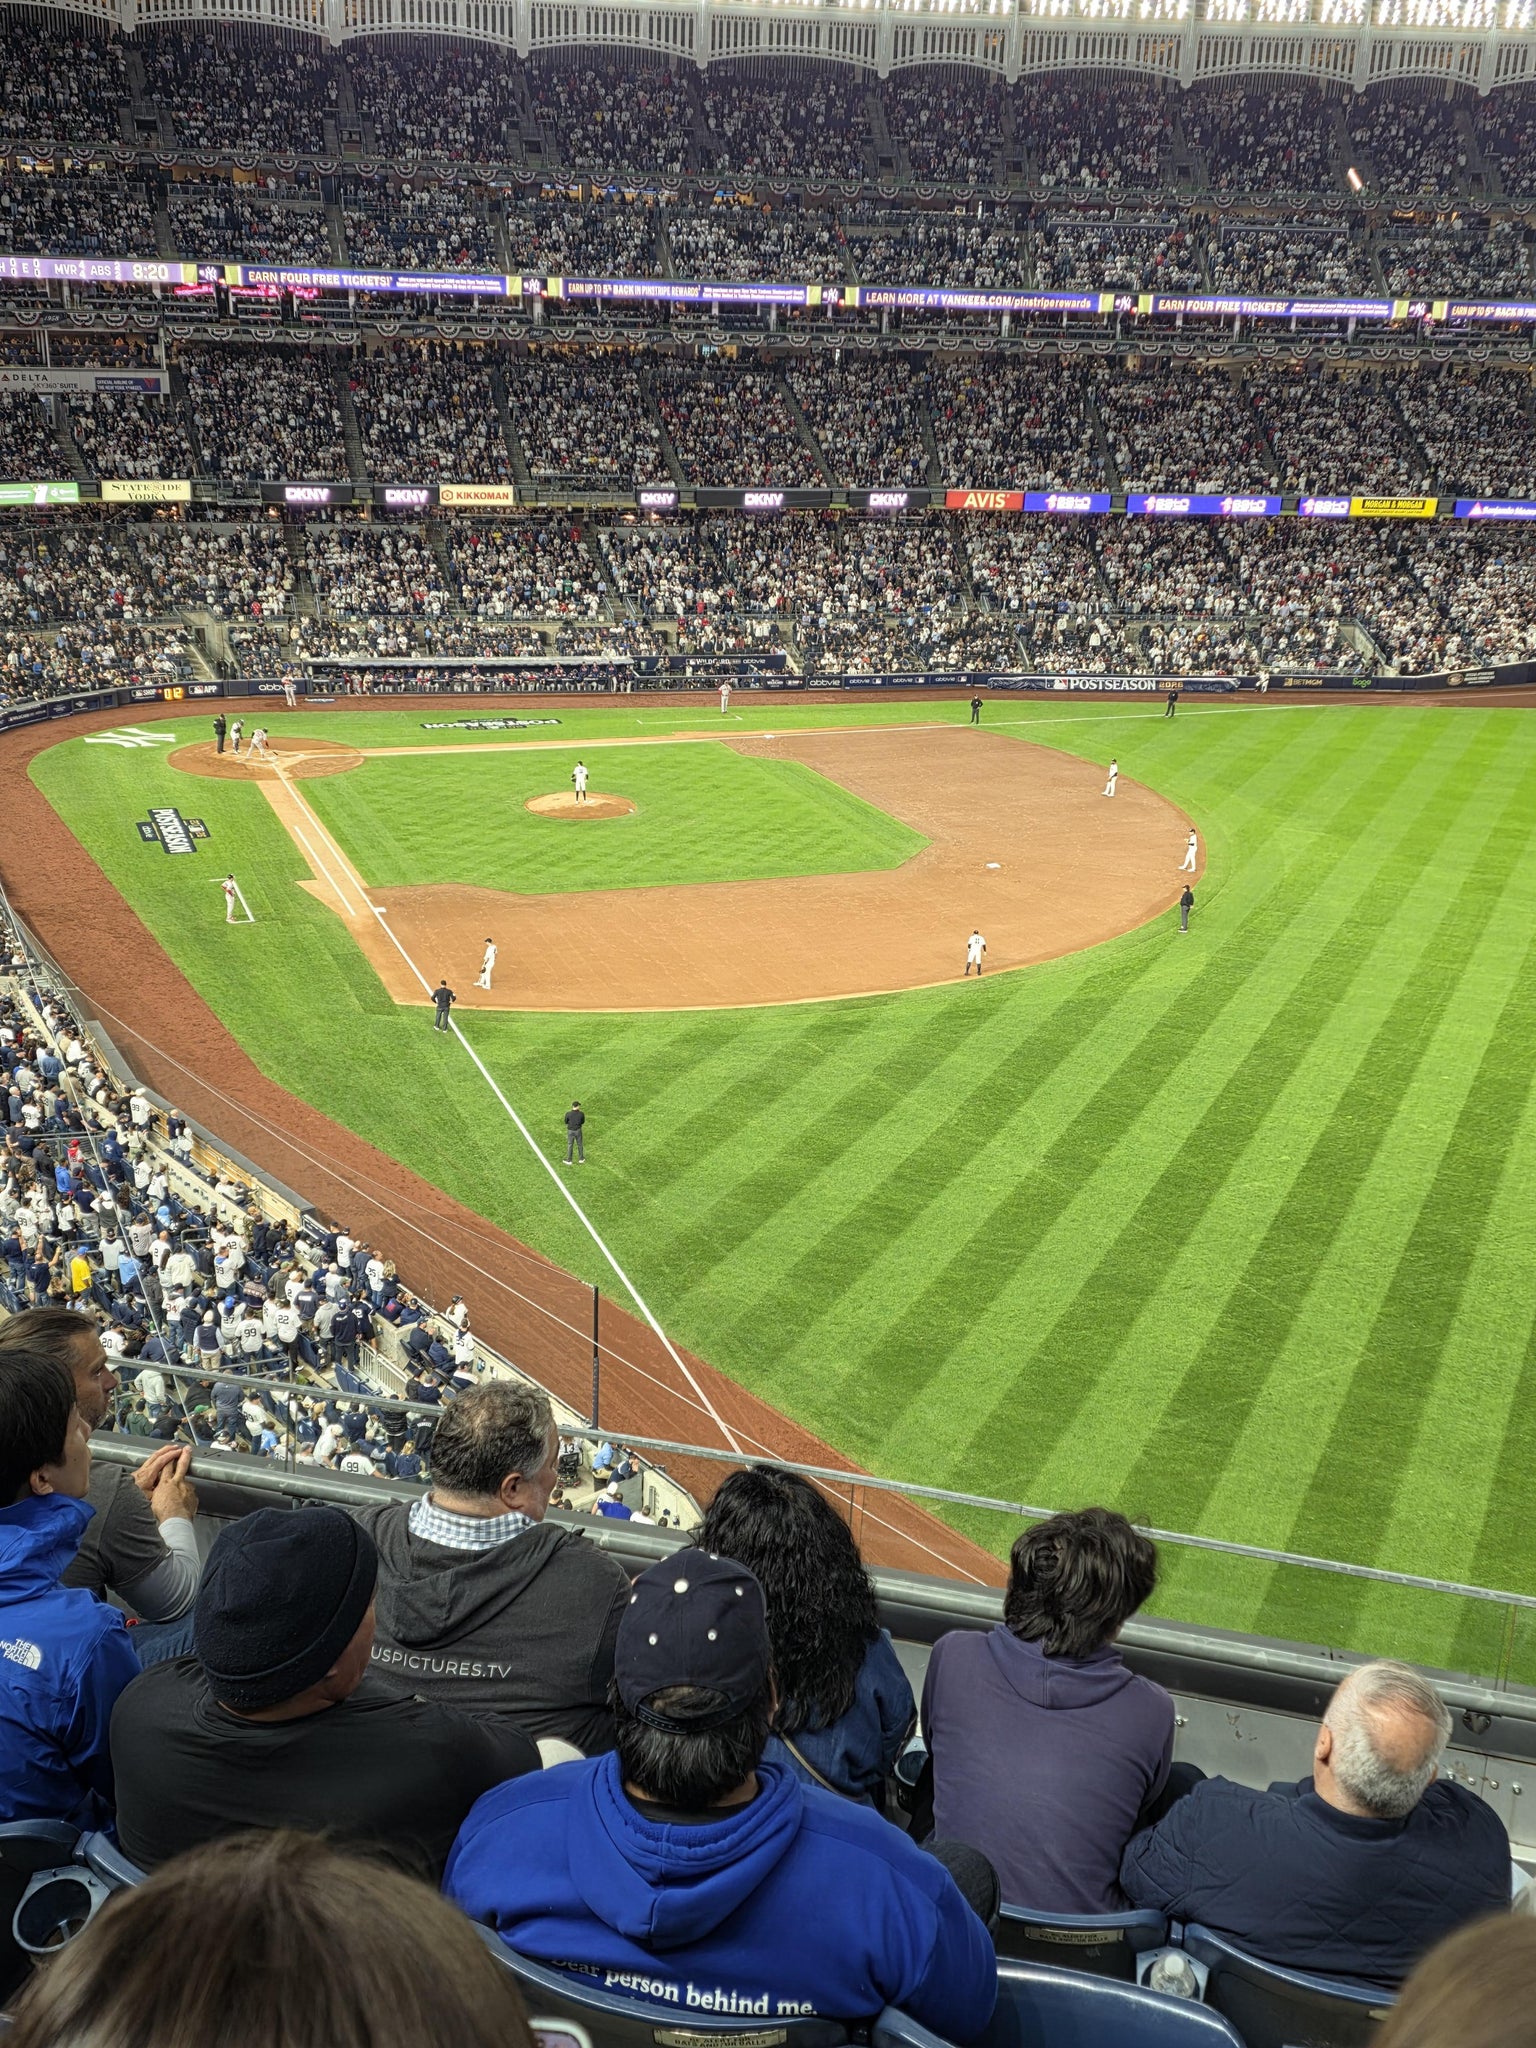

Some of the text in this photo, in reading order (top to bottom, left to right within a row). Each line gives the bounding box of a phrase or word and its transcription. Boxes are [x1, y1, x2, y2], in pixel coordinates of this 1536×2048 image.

[54, 264, 77, 275] MVR
[90, 265, 112, 277] ABS
[132, 264, 168, 280] 8:20
[248, 271, 277, 283] EARN
[280, 272, 310, 285] FOUR
[312, 273, 340, 286] FREE
[568, 283, 583, 294] EARN
[585, 284, 593, 295] UP
[594, 284, 601, 295] TO
[613, 284, 634, 296] BACK
[635, 285, 642, 296] IN
[866, 292, 895, 303] LEARN
[897, 293, 926, 304] MORE
[927, 294, 938, 304] AT
[1158, 300, 1185, 311] EARN
[1186, 300, 1215, 312] FOUR
[1216, 301, 1241, 312] FREE
[12, 374, 48, 382] DELTA
[128, 492, 167, 501] VODKA
[285, 488, 328, 501] DKNY
[385, 490, 428, 503] DKNY
[456, 491, 509, 501] KIKKOMAN
[641, 493, 674, 504] DKNY
[745, 493, 783, 505] DKNY
[870, 493, 907, 505] DKNY
[963, 493, 1006, 508] AVIS
[1363, 499, 1391, 509] MORGAN
[1396, 500, 1424, 509] MORGAN
[809, 677, 841, 687] abbvie
[1070, 679, 1156, 690] POSTSEASON
[151, 808, 193, 853] POSTSEASON
[132, 1233, 139, 1243] 2
[277, 1314, 289, 1325] 22
[243, 1327, 257, 1338] 99
[101, 1337, 113, 1347] 20
[346, 1461, 359, 1473] 99
[0, 1640, 28, 1657] NORTH
[15, 1638, 31, 1650] THE
[3, 1651, 24, 1665] FACE
[370, 1645, 512, 1679] USPICTURES.TV
[604, 1968, 679, 2002] person
[686, 1981, 769, 2016] behind
[776, 1998, 818, 2016] me.
